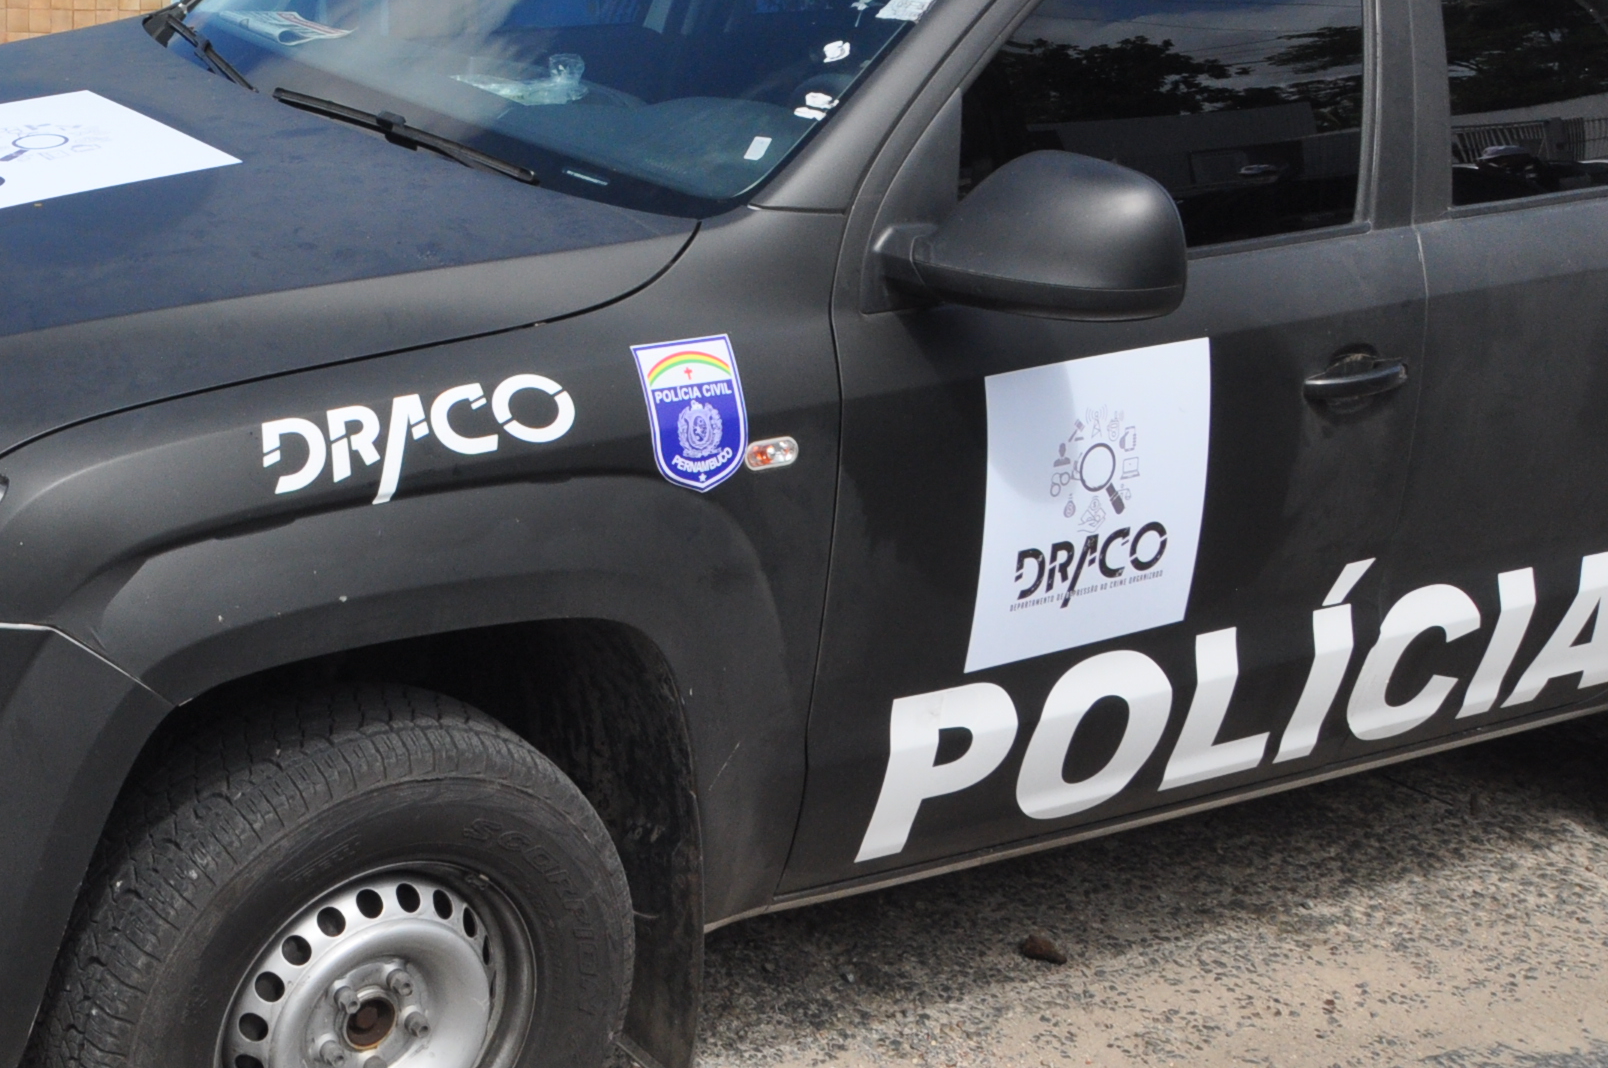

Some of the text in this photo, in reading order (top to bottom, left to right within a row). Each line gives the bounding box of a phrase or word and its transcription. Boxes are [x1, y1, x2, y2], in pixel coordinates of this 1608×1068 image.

[654, 382, 732, 404] POLÍCIA CIVIL
[262, 373, 575, 505] DRACO
[672, 447, 733, 473] PERNAMBUCO
[1009, 594, 1055, 612] DEPARTAMENTO
[1056, 591, 1064, 602] DE
[1100, 582, 1108, 591] AO
[1109, 578, 1127, 589] CRIME
[1013, 521, 1168, 609] DRACO
[853, 550, 1608, 864] POLÍCIA
